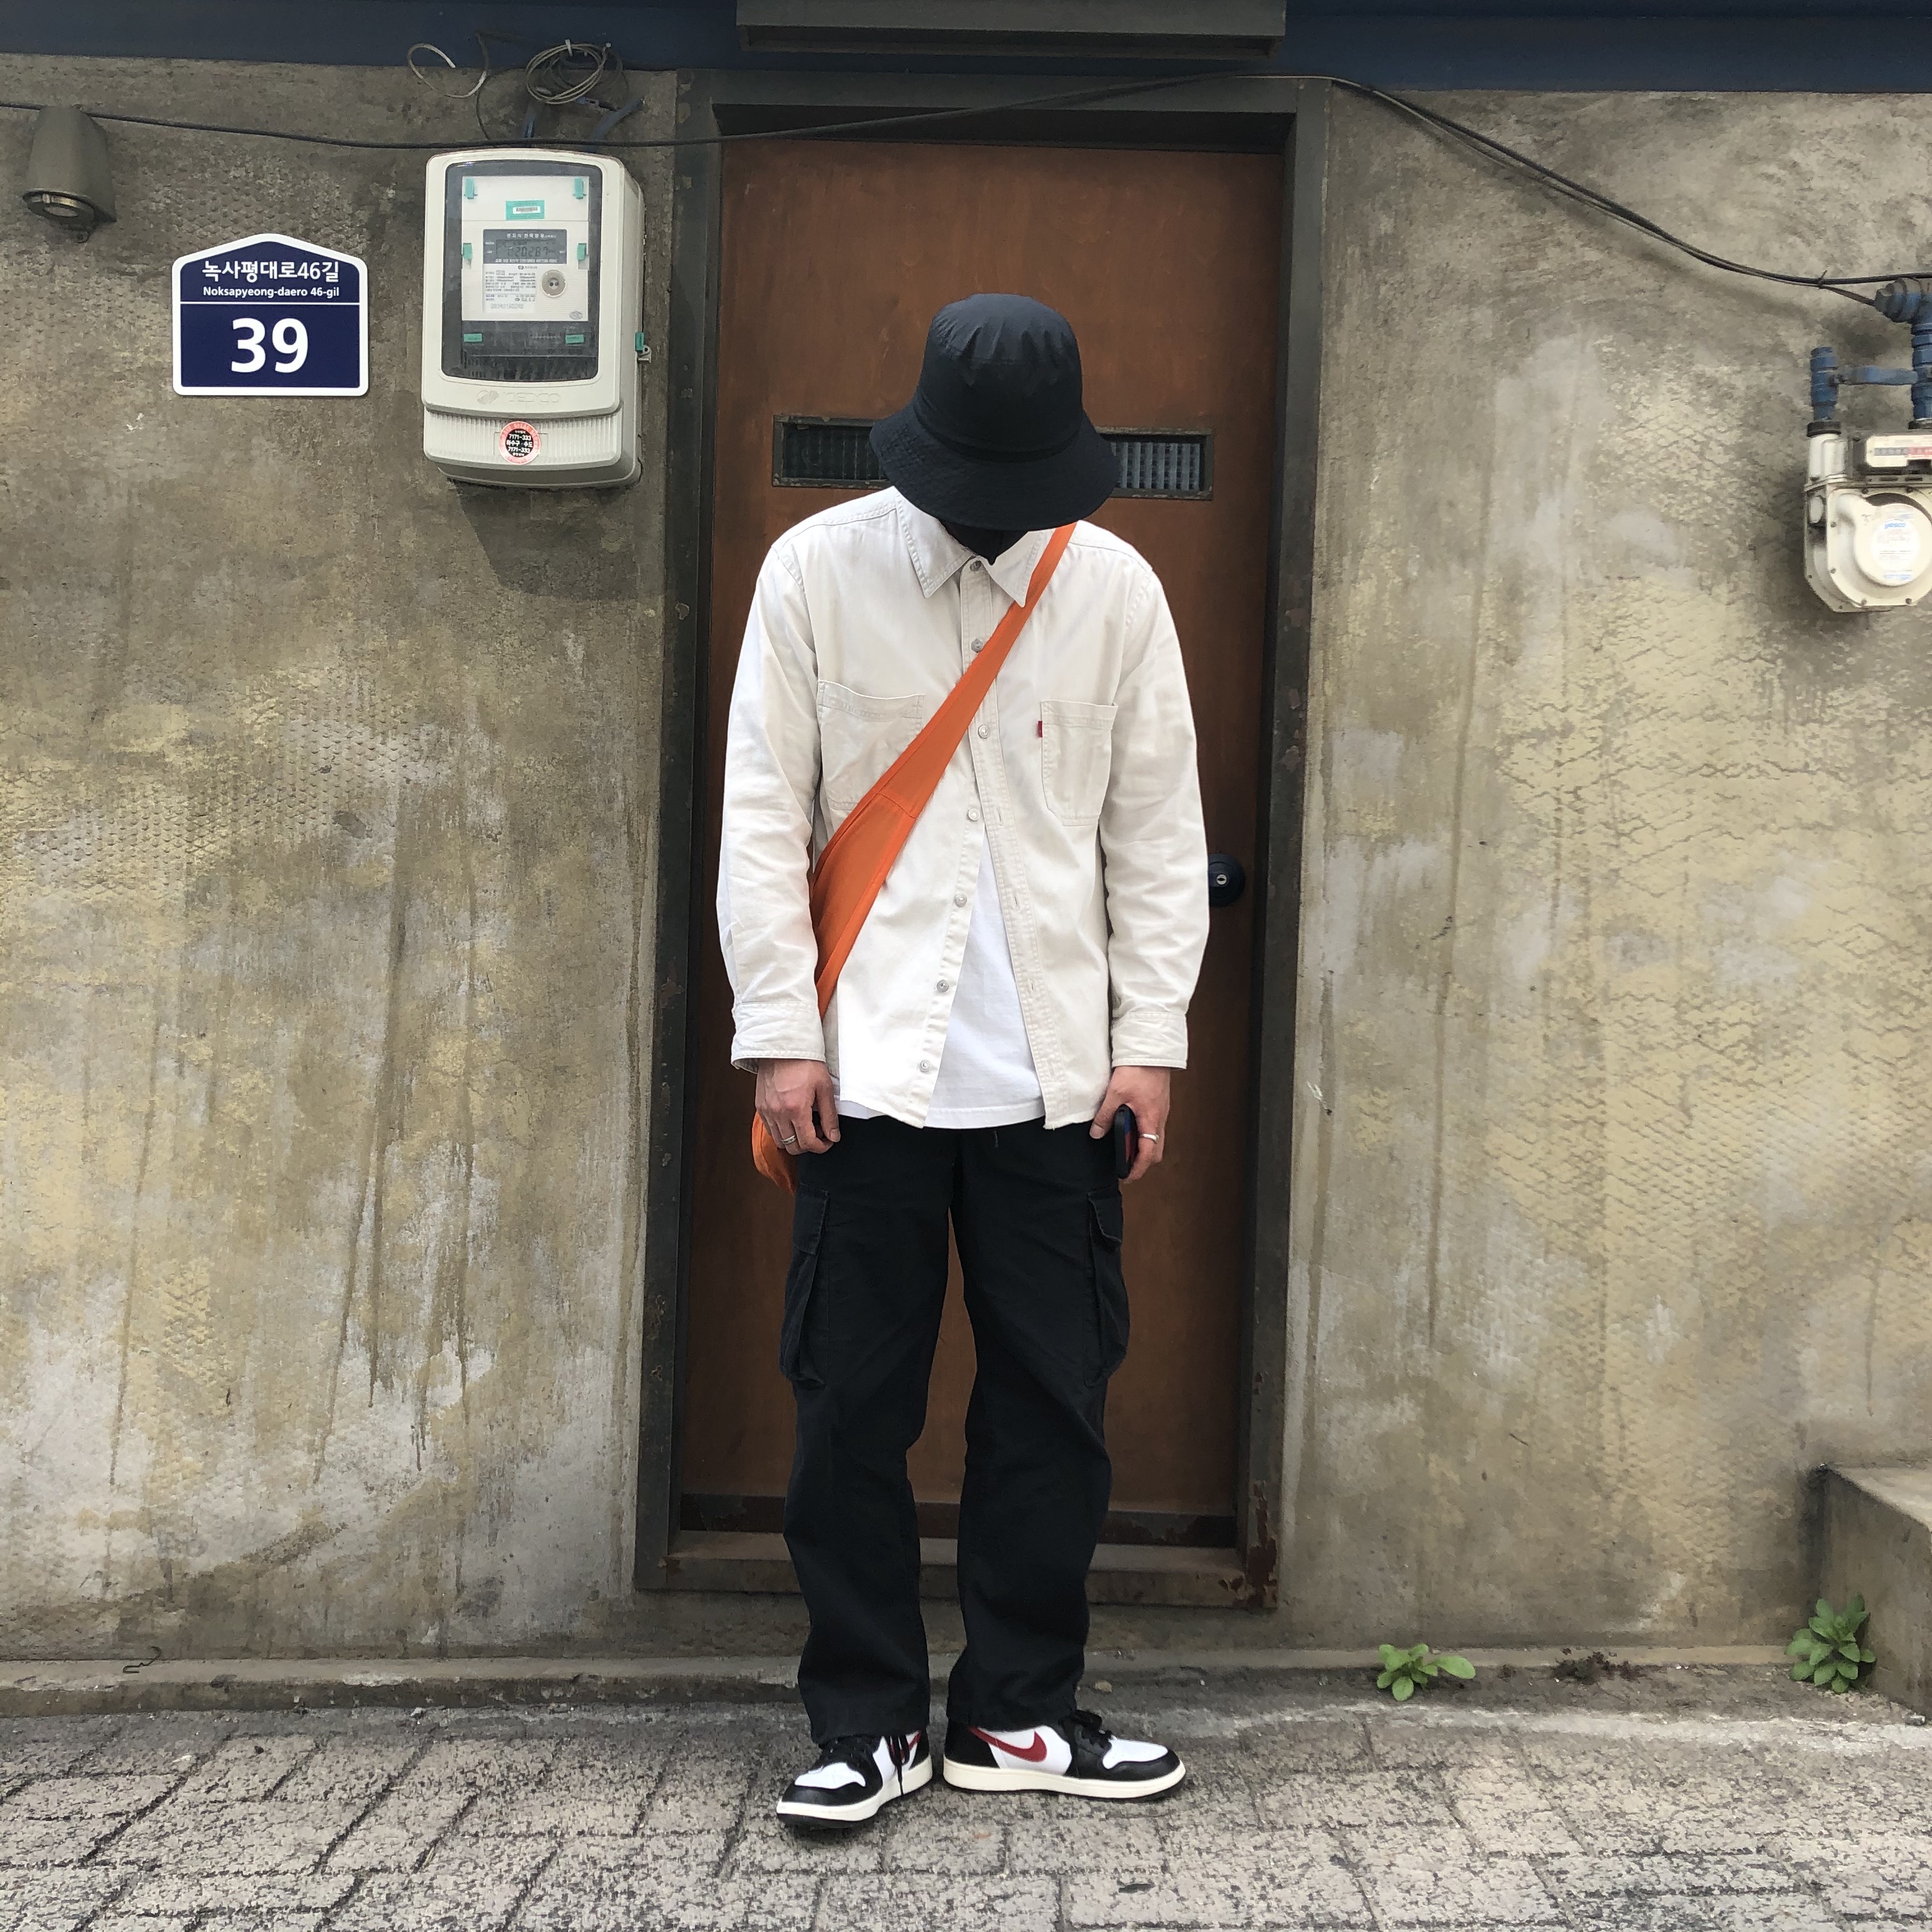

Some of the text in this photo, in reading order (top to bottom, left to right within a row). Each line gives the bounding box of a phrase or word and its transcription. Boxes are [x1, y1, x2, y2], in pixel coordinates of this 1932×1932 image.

[202, 261, 339, 282] 녹사평대로46길
[203, 286, 339, 298] Noksapyeong-daero 46-gil
[231, 318, 309, 373] 39
